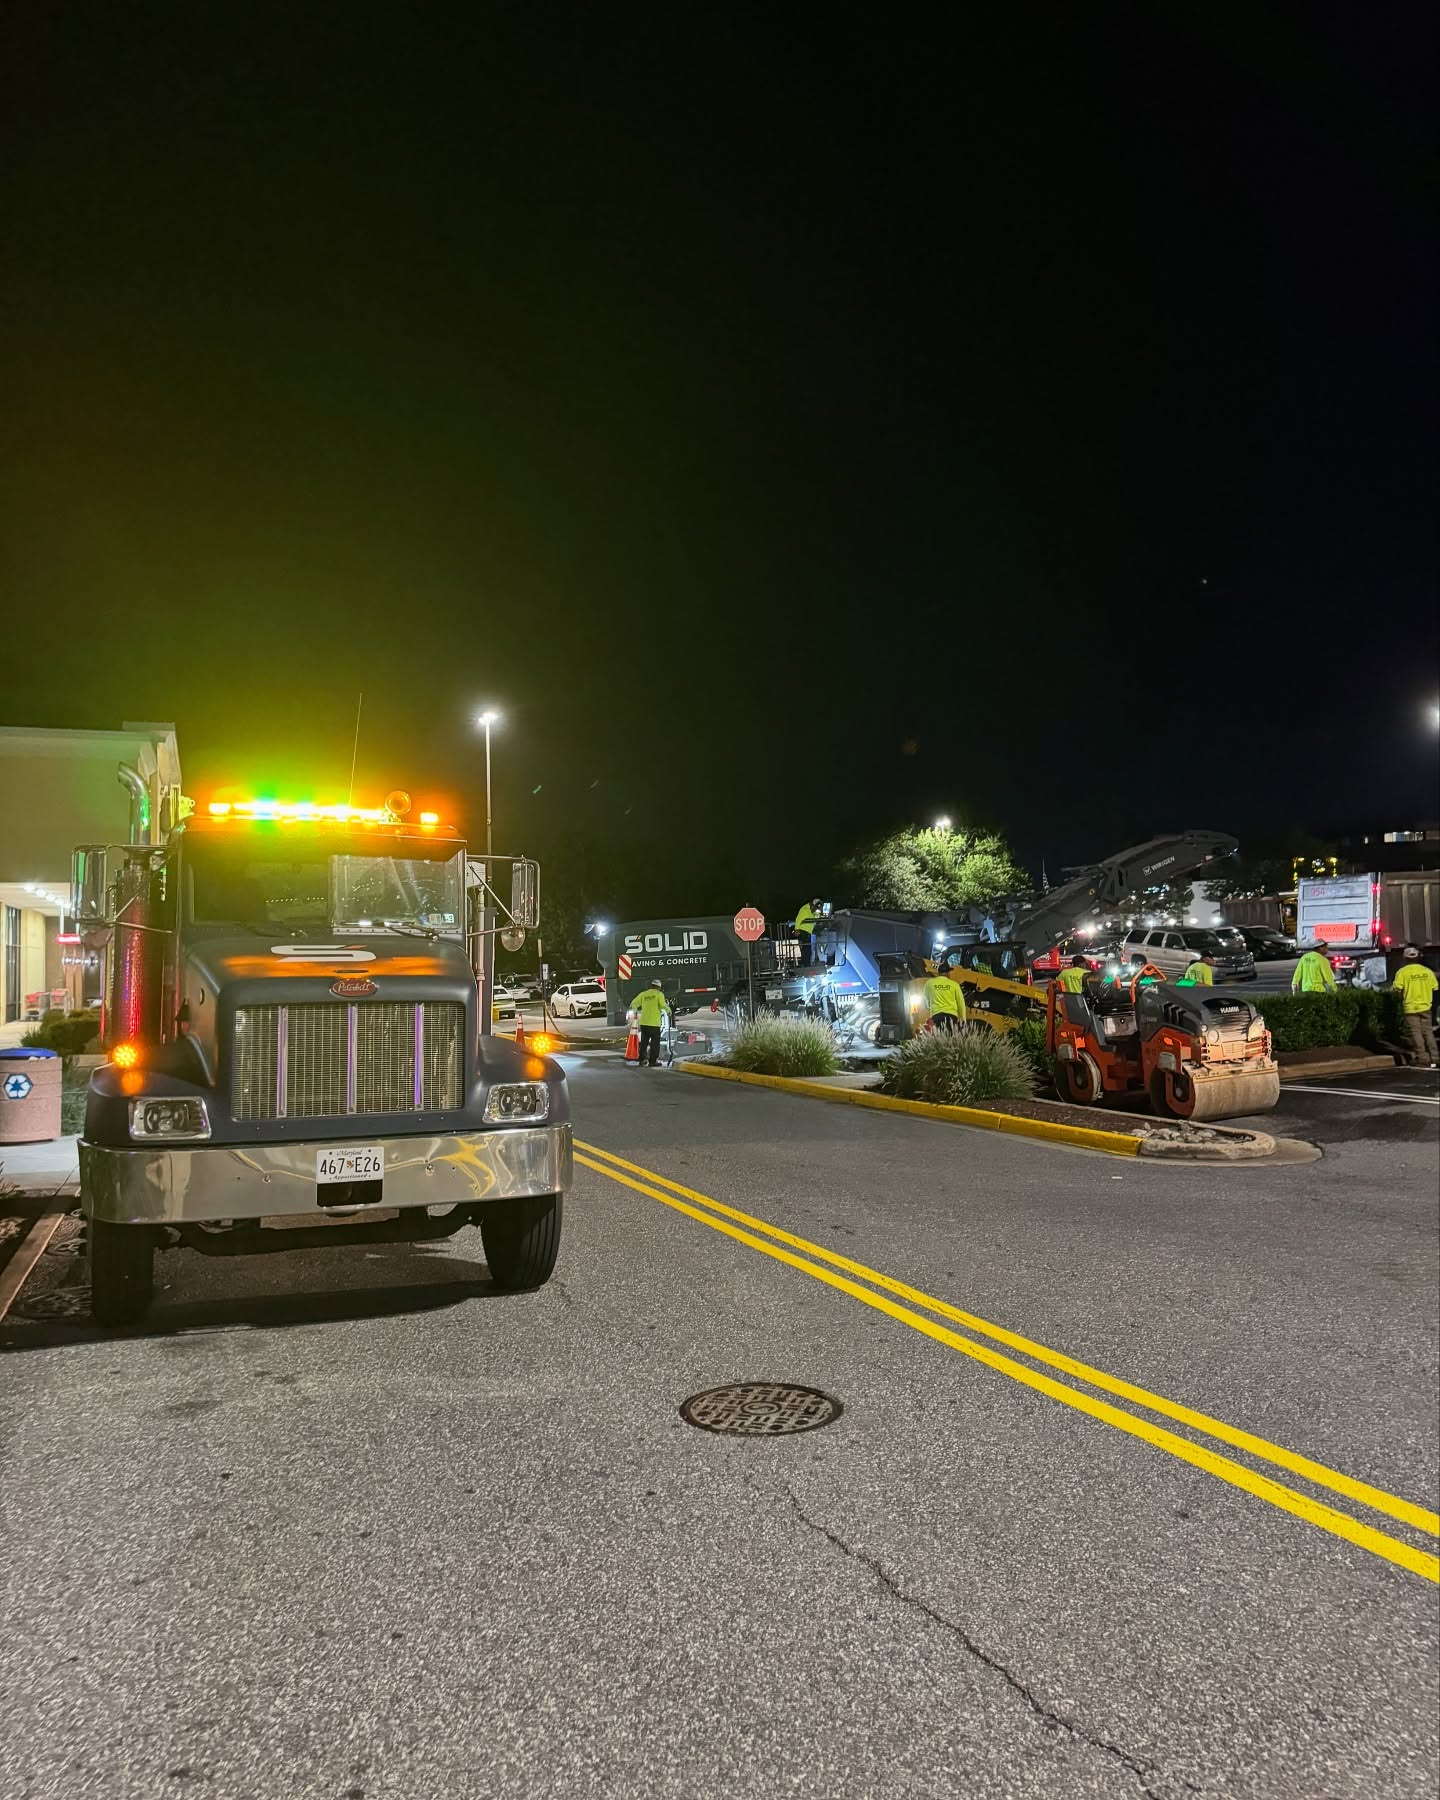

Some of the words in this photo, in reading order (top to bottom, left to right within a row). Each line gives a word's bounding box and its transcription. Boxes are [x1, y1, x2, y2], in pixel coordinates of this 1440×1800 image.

[735, 918, 765, 931] STOP
[624, 931, 708, 954] SOLID
[632, 959, 656, 968] AVING
[666, 956, 707, 965] CONCRETE
[338, 981, 370, 993] Peterbilt
[1220, 1006, 1240, 1014] HAMM
[320, 1157, 345, 1175] 467
[354, 1156, 381, 1173] E26
